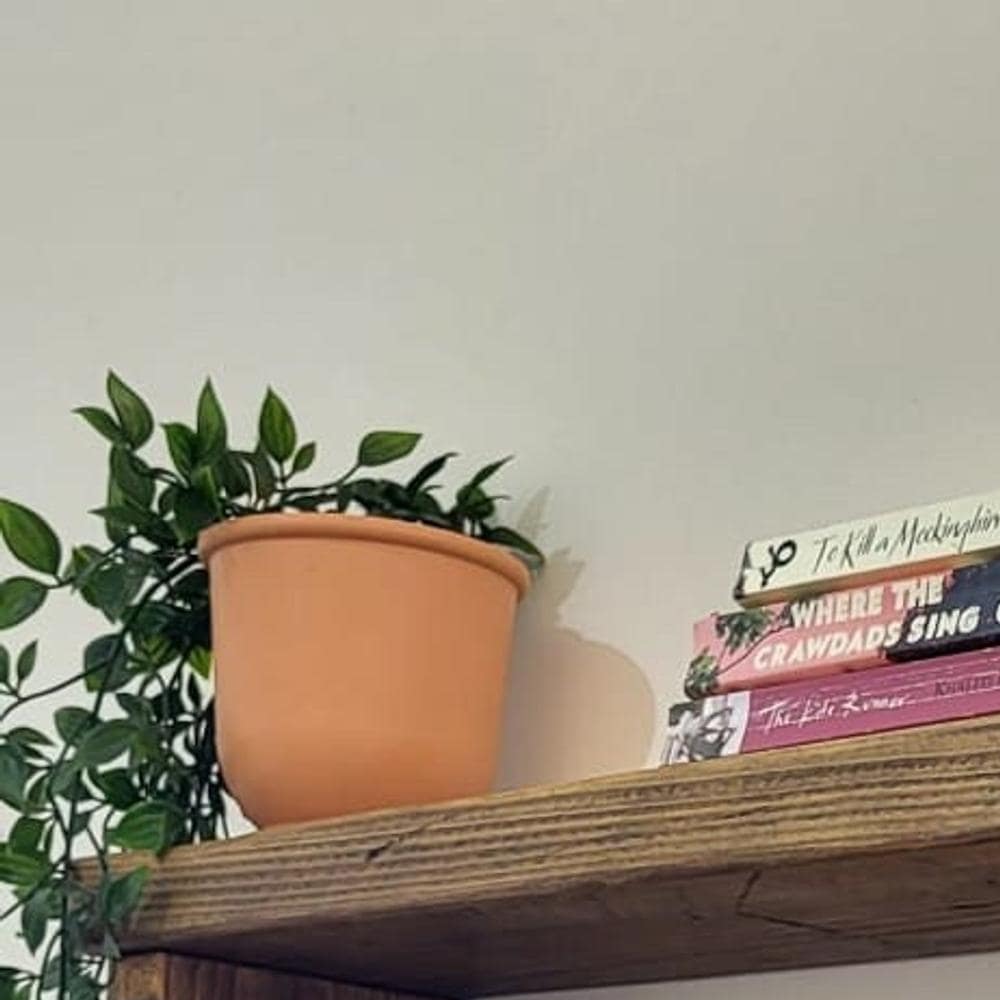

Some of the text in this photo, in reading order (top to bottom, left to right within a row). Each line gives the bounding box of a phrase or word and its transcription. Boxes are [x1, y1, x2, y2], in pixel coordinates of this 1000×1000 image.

[813, 535, 839, 574] To
[840, 524, 878, 568] Kill
[875, 537, 889, 551] a
[790, 573, 946, 628] WHERE THE
[753, 605, 981, 669] CRAWDADS SING
[759, 699, 796, 733] The
